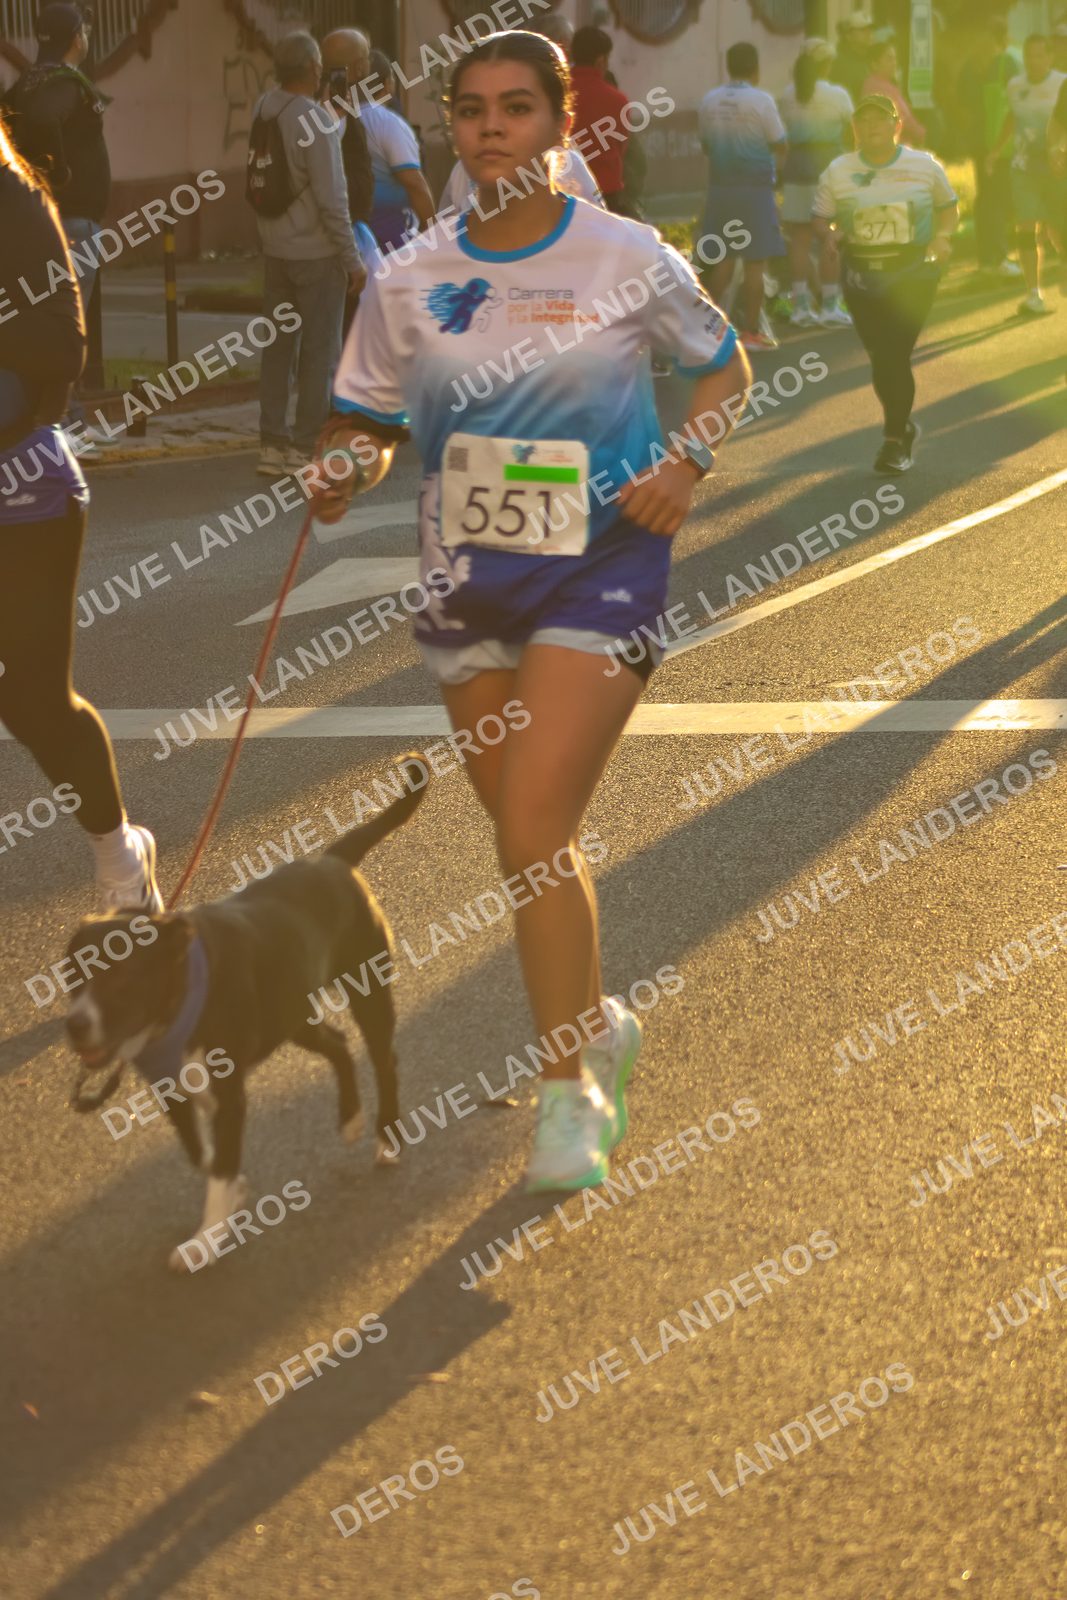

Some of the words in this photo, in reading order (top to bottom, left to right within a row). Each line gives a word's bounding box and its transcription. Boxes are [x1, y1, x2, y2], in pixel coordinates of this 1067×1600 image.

[508, 287, 574, 301] Carrera
[546, 300, 576, 312] Vida
[461, 486, 552, 538] 551
